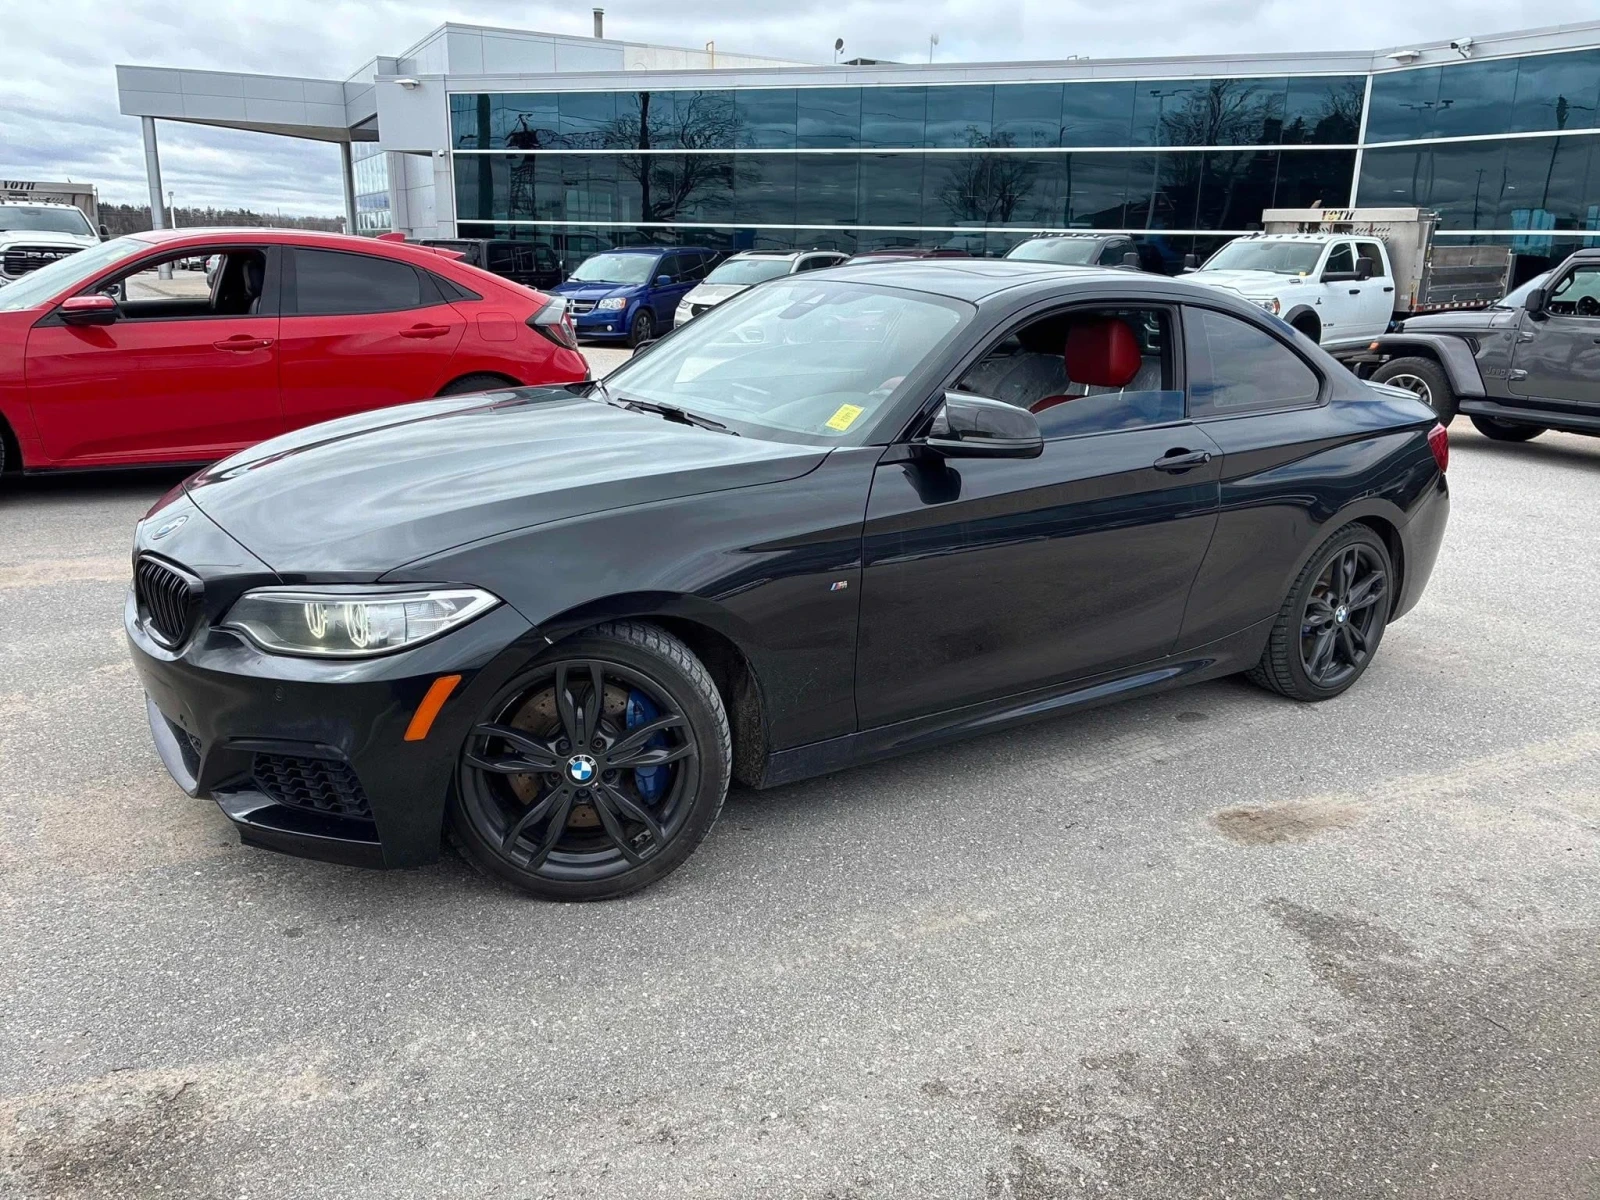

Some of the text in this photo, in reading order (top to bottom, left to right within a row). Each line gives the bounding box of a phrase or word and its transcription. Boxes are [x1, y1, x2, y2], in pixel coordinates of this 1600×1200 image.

[3, 181, 36, 190] VOTH
[1485, 366, 1506, 376] Jeep
[568, 755, 597, 766] BMW
